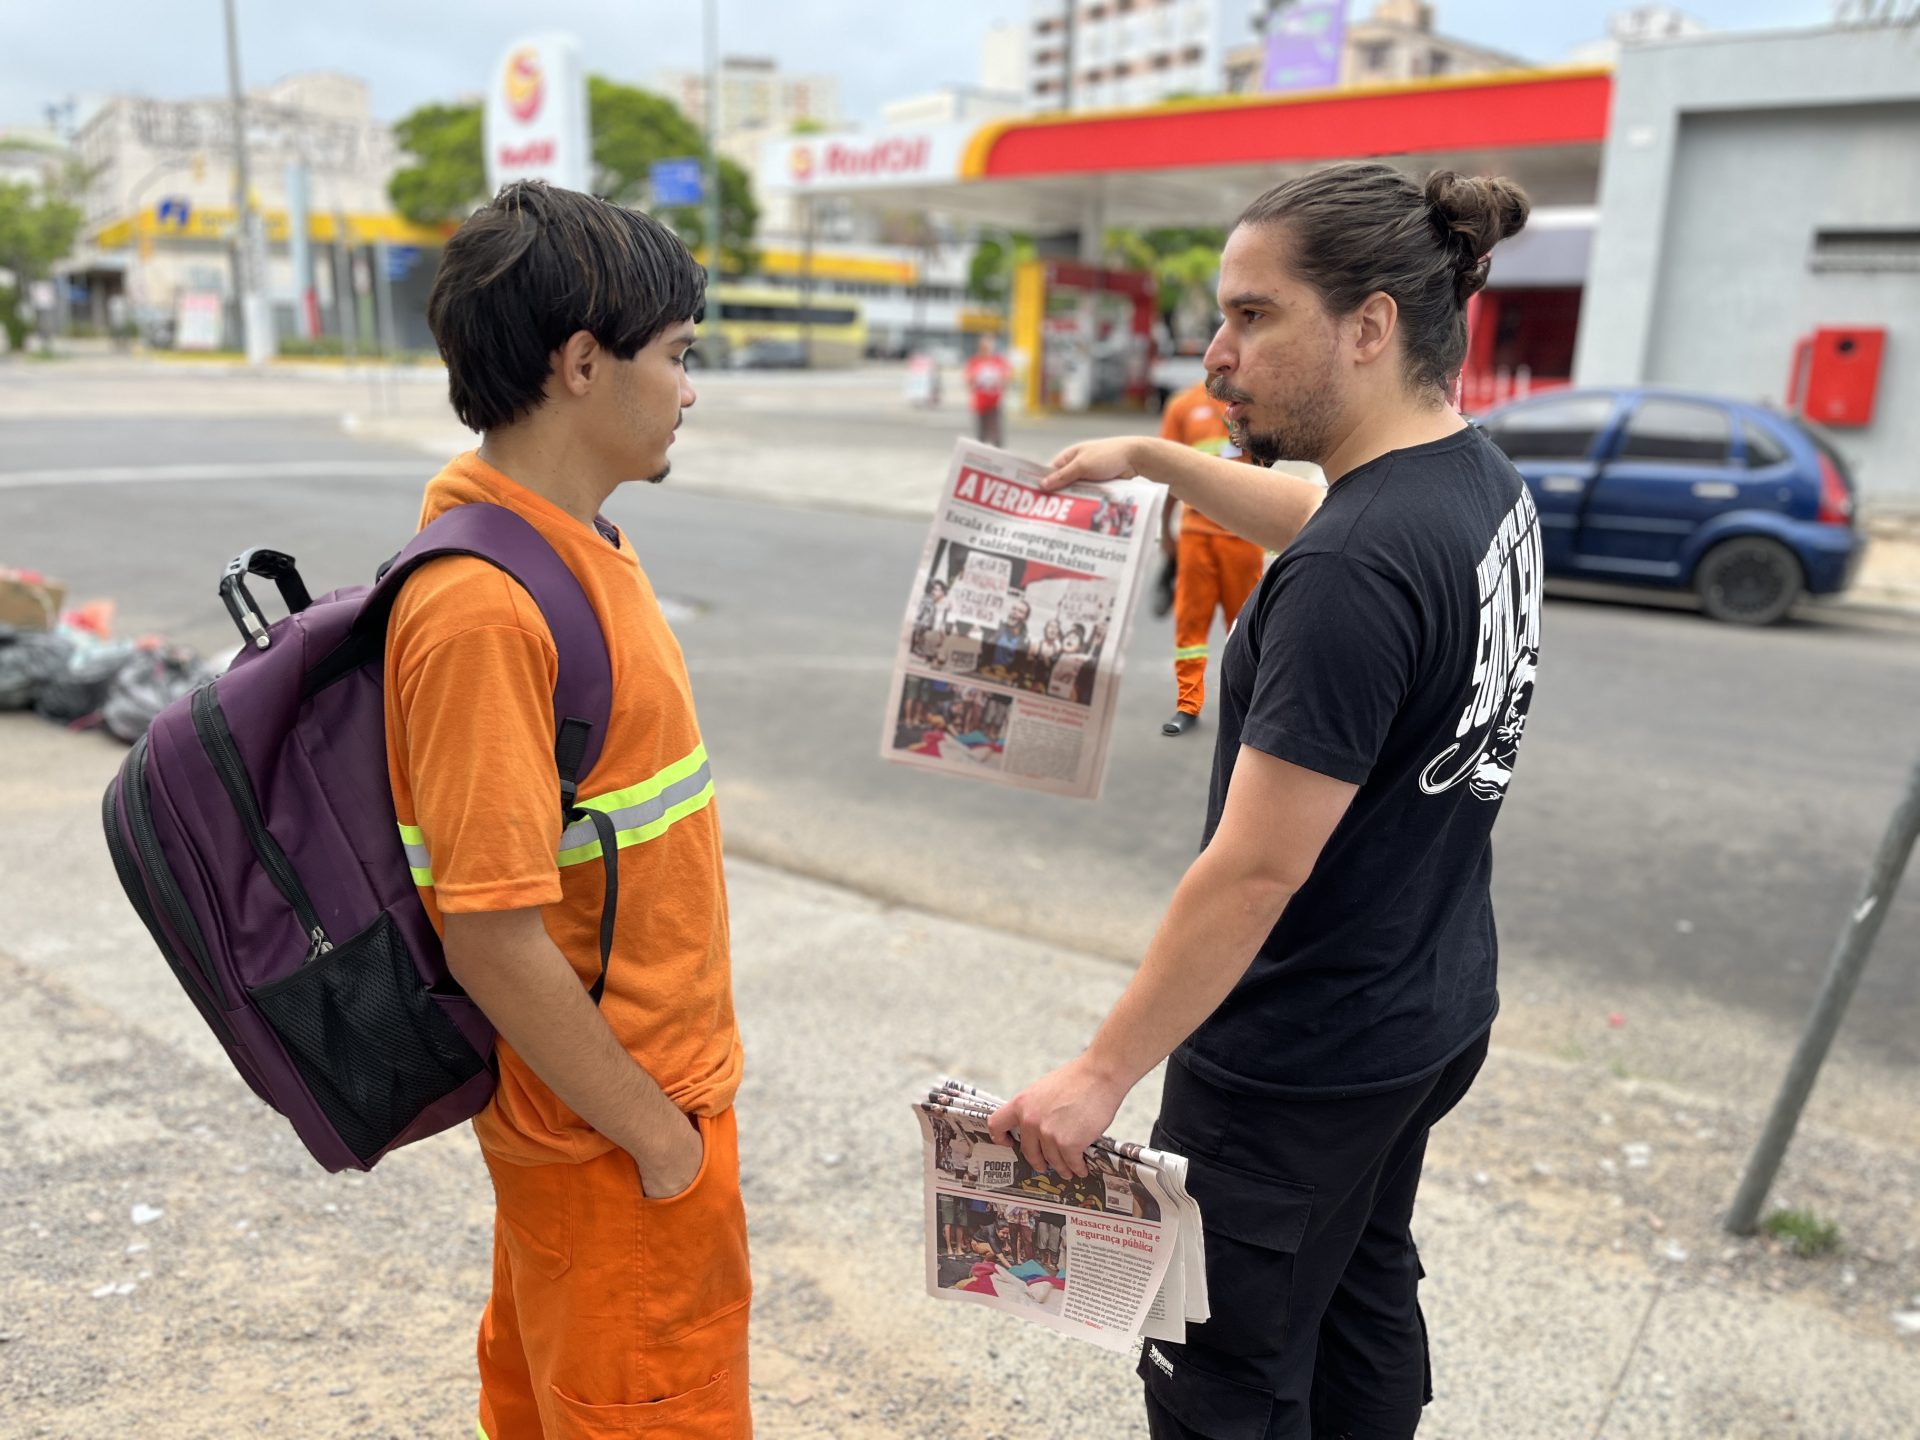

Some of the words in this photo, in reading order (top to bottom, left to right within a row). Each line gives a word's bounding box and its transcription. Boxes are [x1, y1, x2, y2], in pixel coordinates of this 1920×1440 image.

[958, 474, 980, 498] A
[981, 477, 1074, 520] VERDADE
[945, 510, 984, 532] Escala
[1012, 530, 1069, 551] empregos
[1070, 542, 1127, 564] precários
[979, 537, 1024, 556] salários
[1026, 546, 1055, 564] mais
[1056, 552, 1096, 573] baixos
[984, 1161, 1012, 1171] PODER
[984, 1170, 1012, 1179] POPULAR
[1070, 1216, 1112, 1231] Massacre
[1113, 1224, 1124, 1234] da
[1126, 1227, 1153, 1241] Penha
[1155, 1235, 1161, 1243] e
[1076, 1229, 1121, 1245] segurança
[1122, 1237, 1153, 1253] pública
